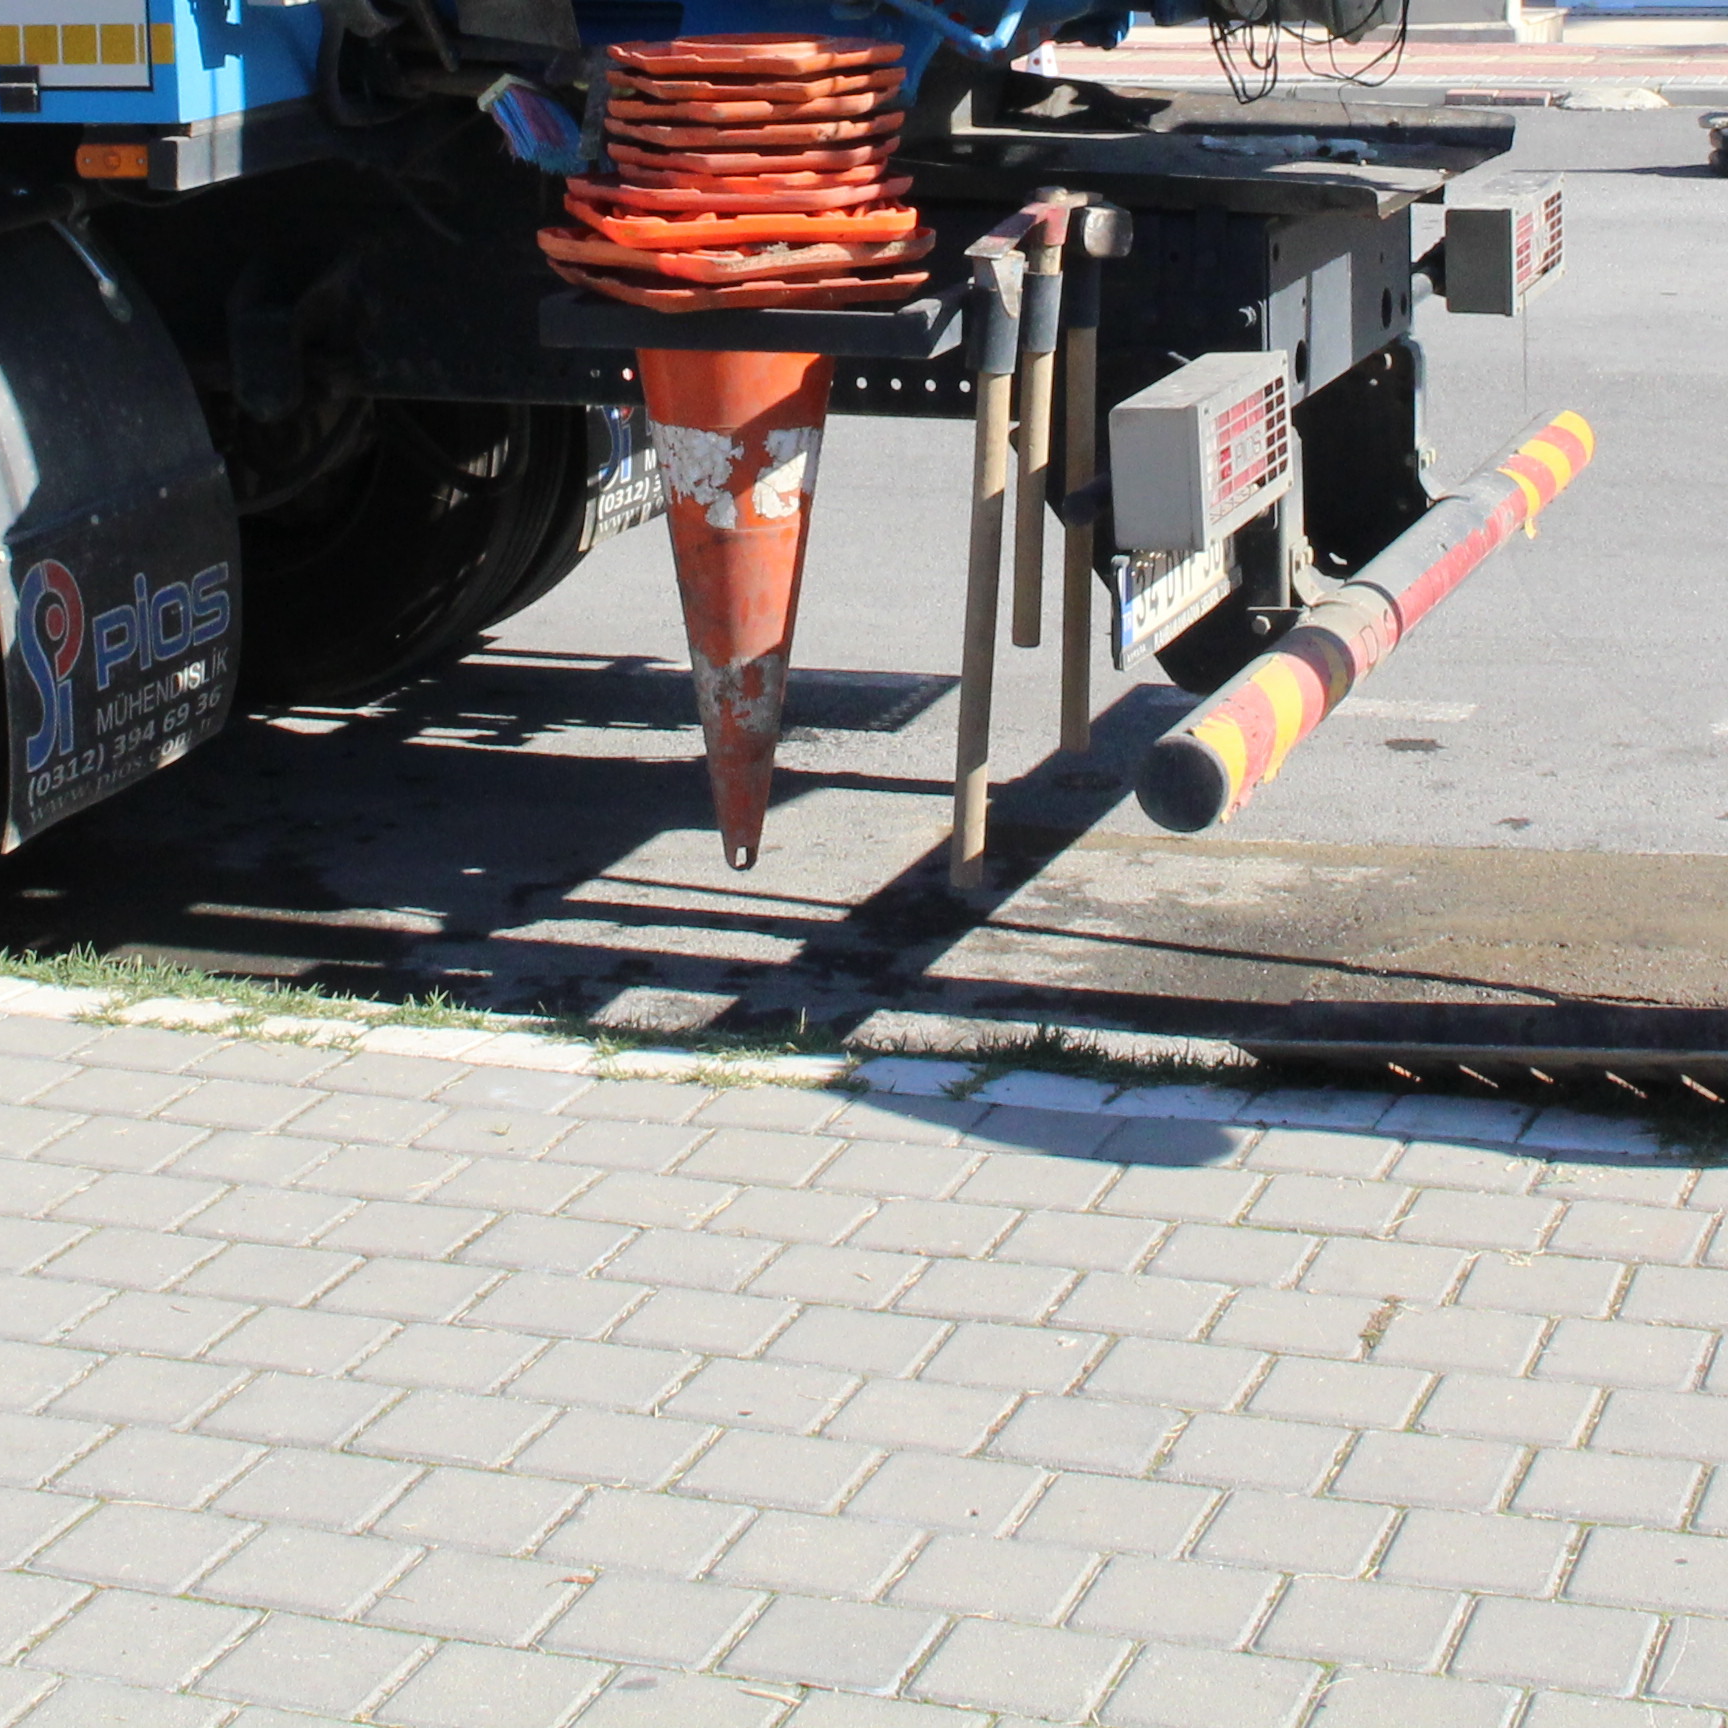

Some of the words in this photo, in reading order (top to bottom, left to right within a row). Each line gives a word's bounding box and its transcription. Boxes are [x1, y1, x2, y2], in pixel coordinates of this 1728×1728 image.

[597, 475, 650, 521] (0312)
[1135, 557, 1160, 627] 34
[96, 645, 229, 736] MÜHENDİSLİK
[28, 742, 104, 807] (0312)
[112, 720, 155, 760] 394
[163, 702, 191, 733] 69
[195, 685, 222, 716] 36
